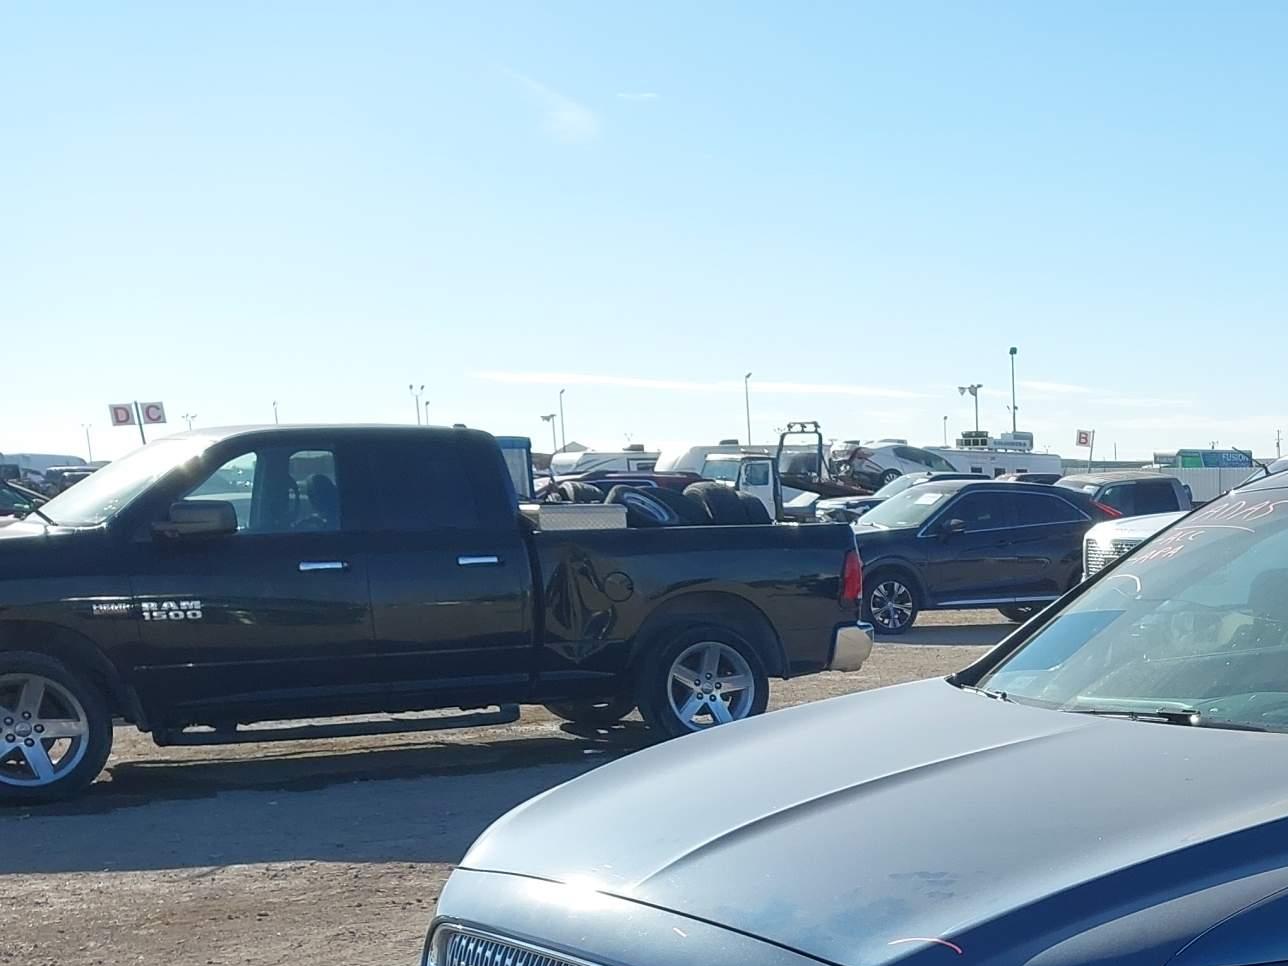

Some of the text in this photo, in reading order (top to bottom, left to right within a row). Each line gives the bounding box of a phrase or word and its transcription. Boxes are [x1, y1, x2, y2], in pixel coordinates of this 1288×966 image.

[113, 406, 130, 423] D
[145, 404, 161, 421] C
[1078, 432, 1088, 444] B
[141, 600, 201, 611] RAM
[142, 610, 202, 620] 1500
